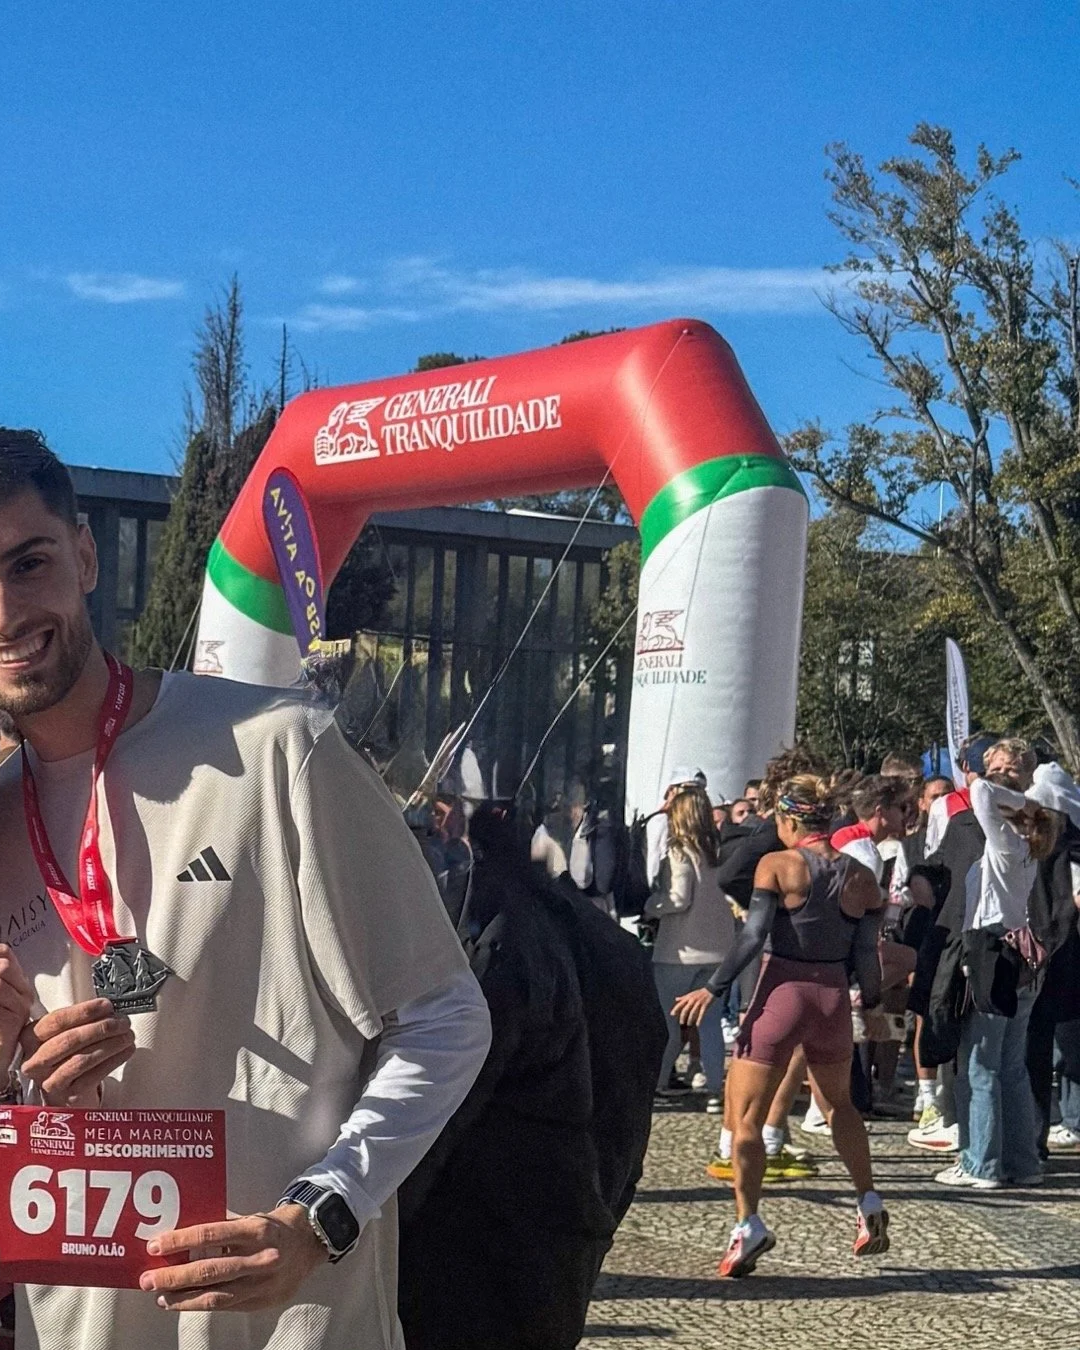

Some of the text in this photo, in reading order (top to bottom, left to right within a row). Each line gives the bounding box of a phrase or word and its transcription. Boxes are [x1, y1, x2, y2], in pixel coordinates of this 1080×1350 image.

[384, 375, 497, 422] GENERALI
[381, 394, 562, 456] TRANQUILIDADE
[84, 1111, 214, 1123] GENERALI TRANQUILIDADE
[85, 1128, 214, 1141] MEIA MARATONA
[84, 1143, 214, 1159] DESCOBRIMENTOS
[9, 1164, 181, 1241] 6179
[61, 1242, 126, 1257] BRUNO ALÃO
